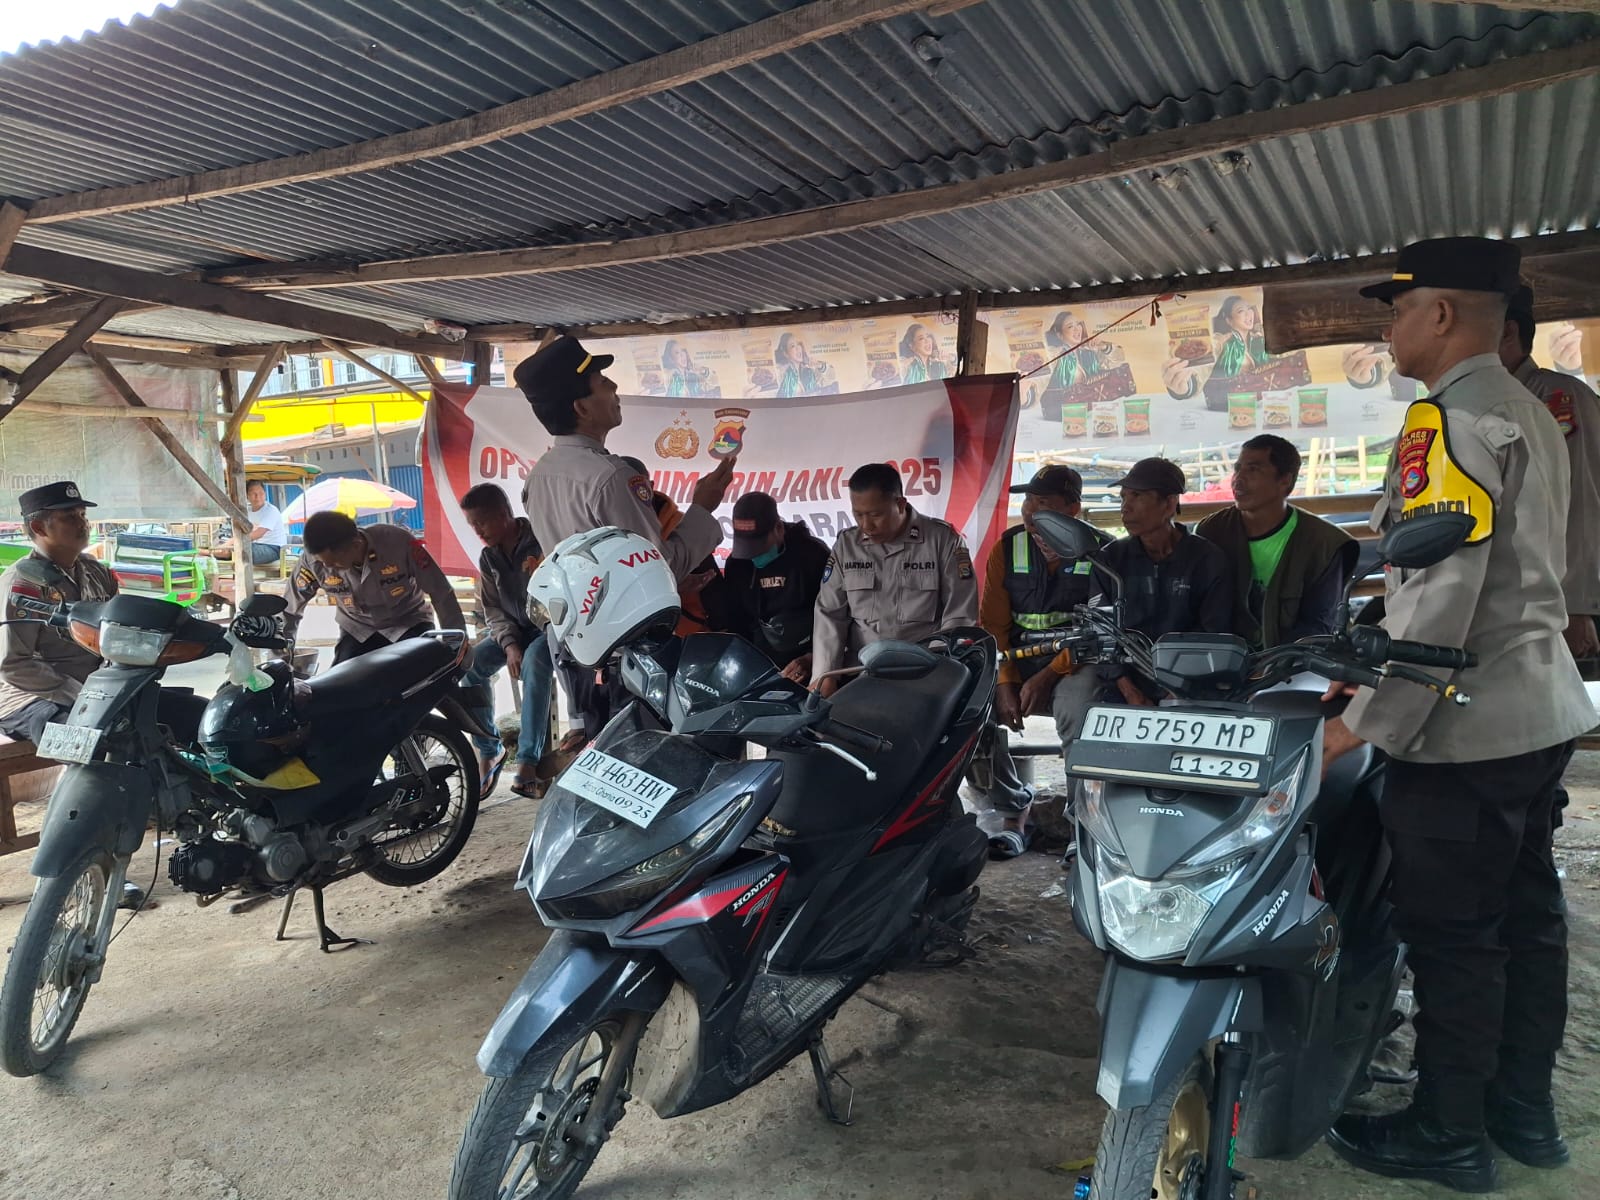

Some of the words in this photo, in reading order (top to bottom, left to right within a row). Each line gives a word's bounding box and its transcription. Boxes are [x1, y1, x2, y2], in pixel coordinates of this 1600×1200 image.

[903, 561, 935, 570] POLRI
[580, 576, 603, 615] VIAR
[684, 678, 721, 697] HONDA
[1092, 714, 1126, 739] DR
[1135, 717, 1206, 745] 5759
[1215, 723, 1255, 748] MP
[577, 751, 606, 774] DR
[600, 761, 637, 788] 4463
[632, 776, 672, 802] HW
[632, 805, 653, 819] 25
[1139, 806, 1185, 817] HONDA
[732, 871, 777, 912] HONDA
[1252, 889, 1290, 937] HONDA
